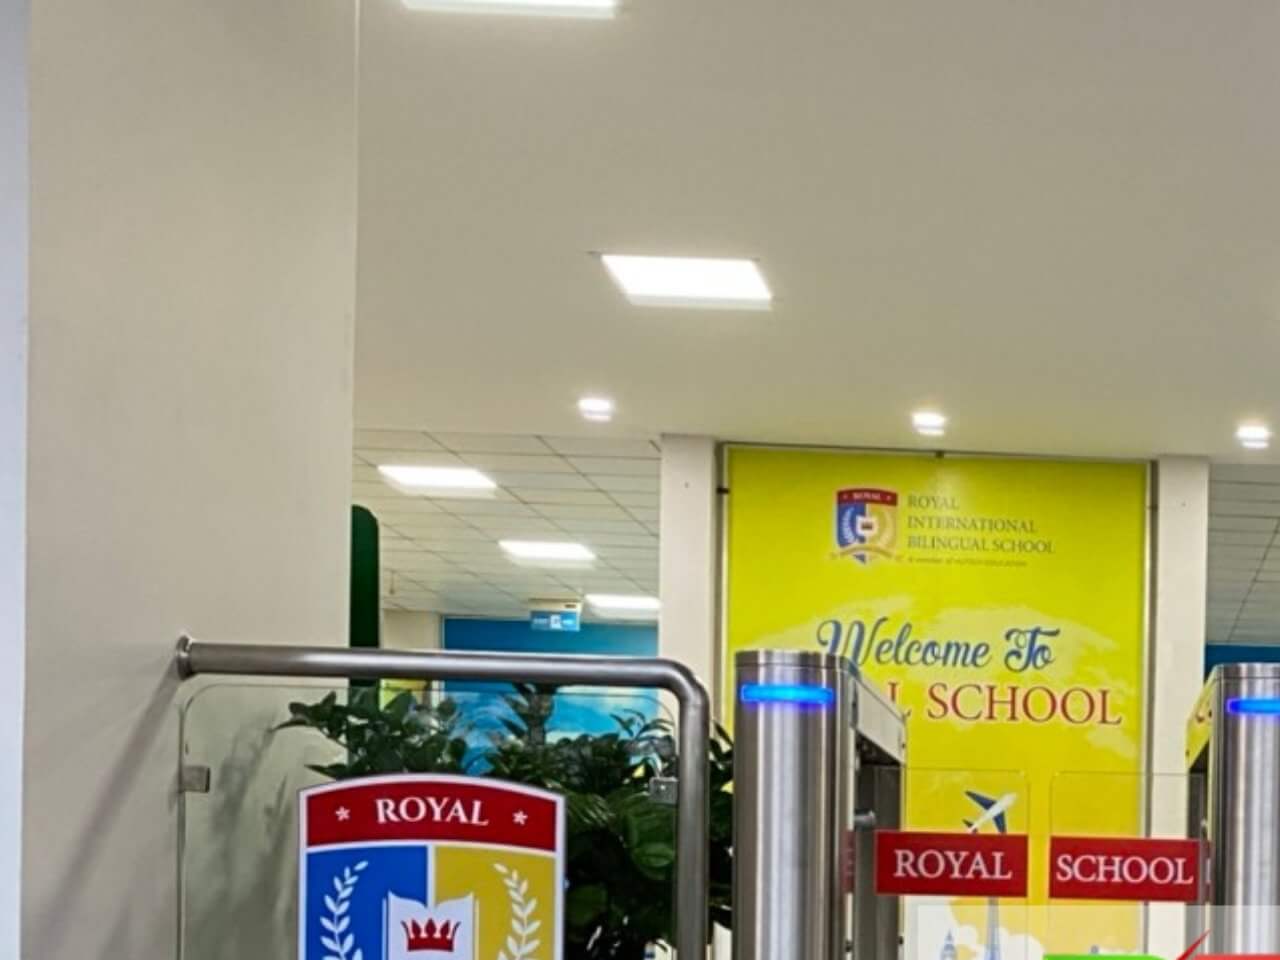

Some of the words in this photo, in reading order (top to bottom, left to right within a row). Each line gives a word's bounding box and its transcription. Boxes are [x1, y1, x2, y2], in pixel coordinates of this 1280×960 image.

[907, 495, 960, 511] ROYAL
[907, 515, 1038, 534] INTERNATIONAL
[907, 536, 990, 552] BILINGUAL
[991, 538, 1057, 555] SCHOOL
[816, 616, 991, 667] Welcome
[1004, 626, 1060, 673] To
[927, 682, 1122, 726] SCHOOL
[375, 797, 489, 827] ROYAL
[893, 849, 1013, 881] ROYAL
[1056, 854, 1194, 885] SCHOOL
